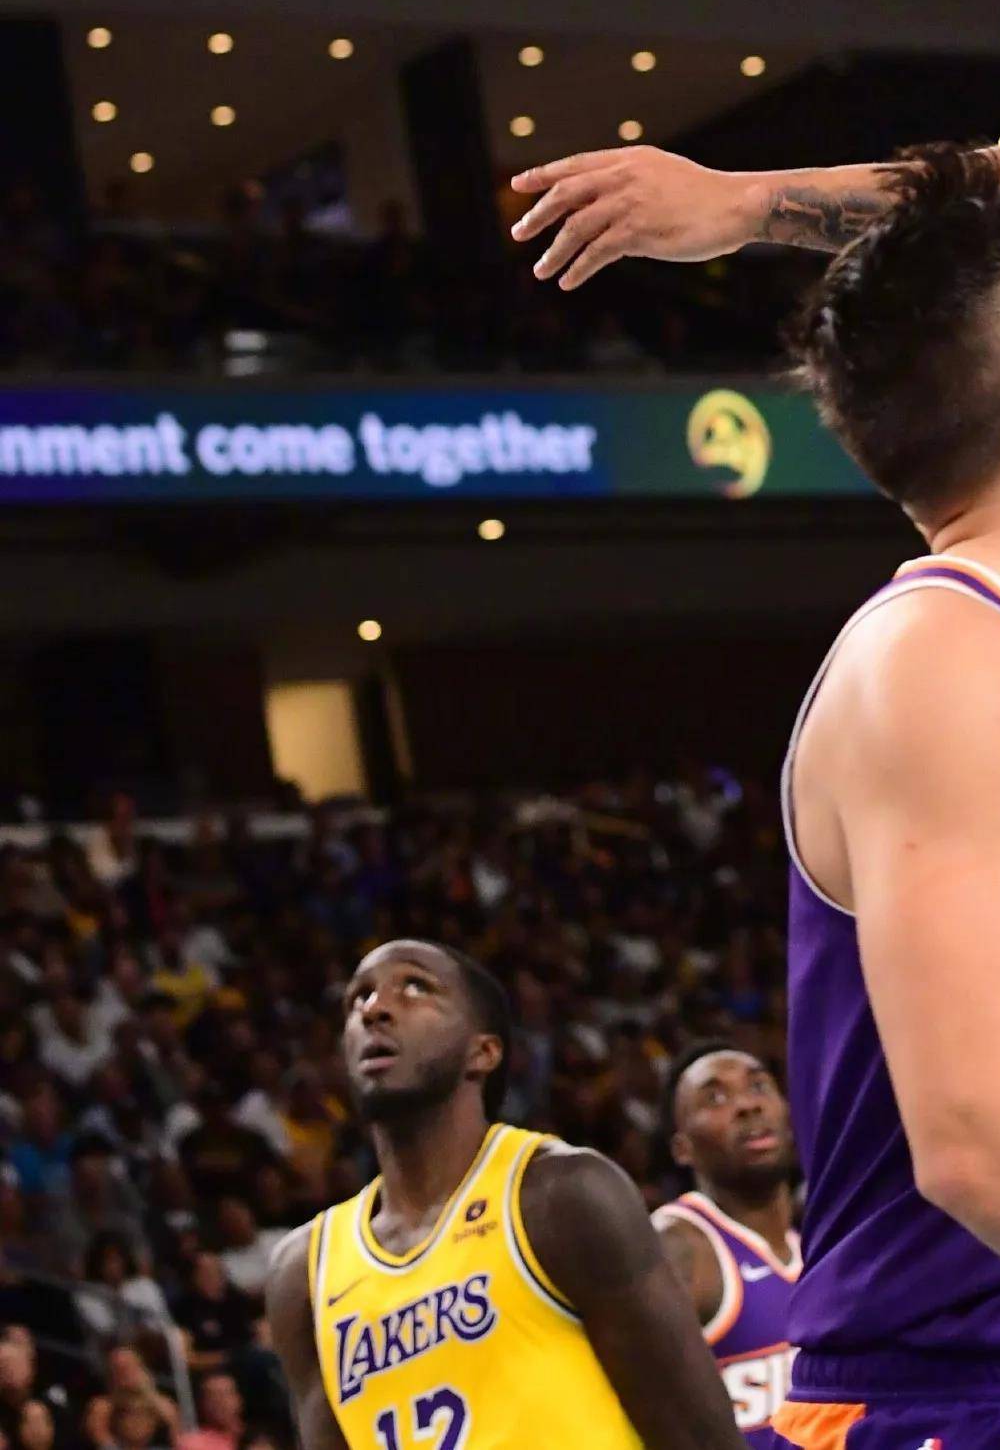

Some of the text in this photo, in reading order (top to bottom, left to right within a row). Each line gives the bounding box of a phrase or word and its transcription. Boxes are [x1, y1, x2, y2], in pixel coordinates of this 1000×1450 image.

[197, 423, 355, 475] come
[358, 411, 597, 487] together
[336, 1274, 496, 1405] LAKERS
